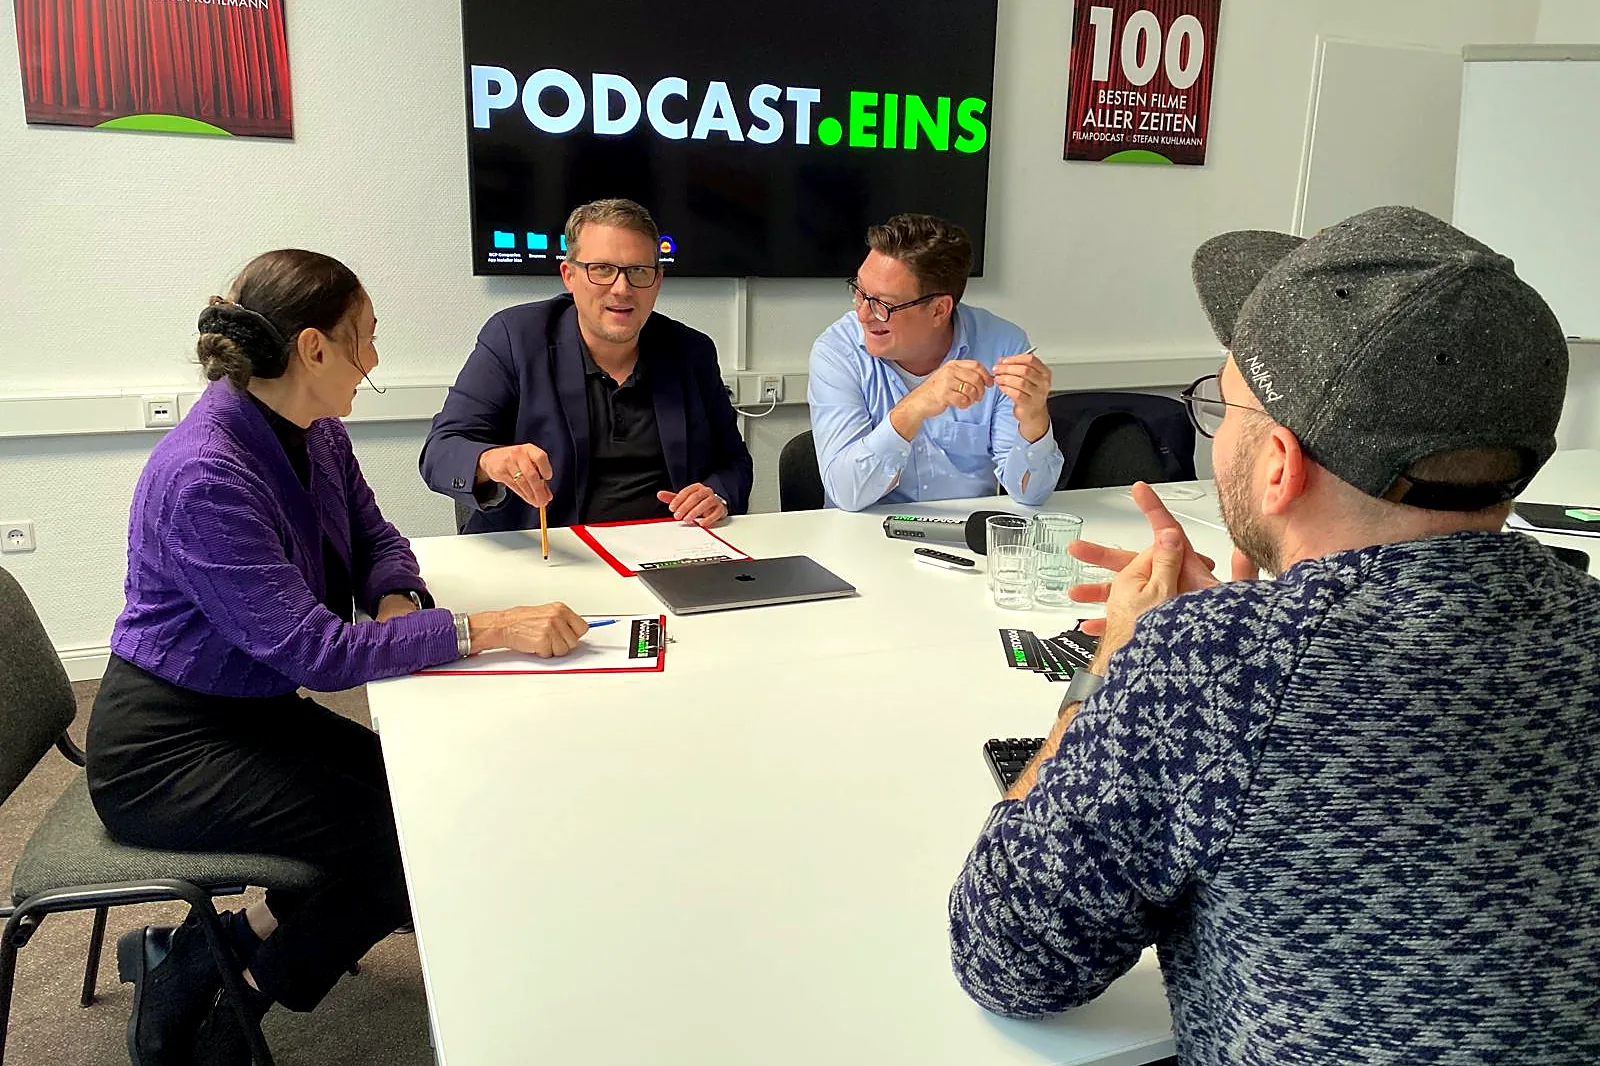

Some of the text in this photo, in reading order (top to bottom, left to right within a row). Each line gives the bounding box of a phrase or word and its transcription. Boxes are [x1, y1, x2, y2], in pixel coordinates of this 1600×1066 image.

[1089, 6, 1204, 89] 100
[470, 65, 987, 154] PODCAST.EINS
[1098, 89, 1187, 110] BESTEN FILME
[1082, 108, 1197, 133] ALLER ZEITEN
[1072, 131, 1125, 142] FILMPODCAST
[1132, 134, 1160, 144] STEFAN
[1160, 136, 1203, 146] KUHLMANN
[1057, 637, 1095, 660] PODCAS
